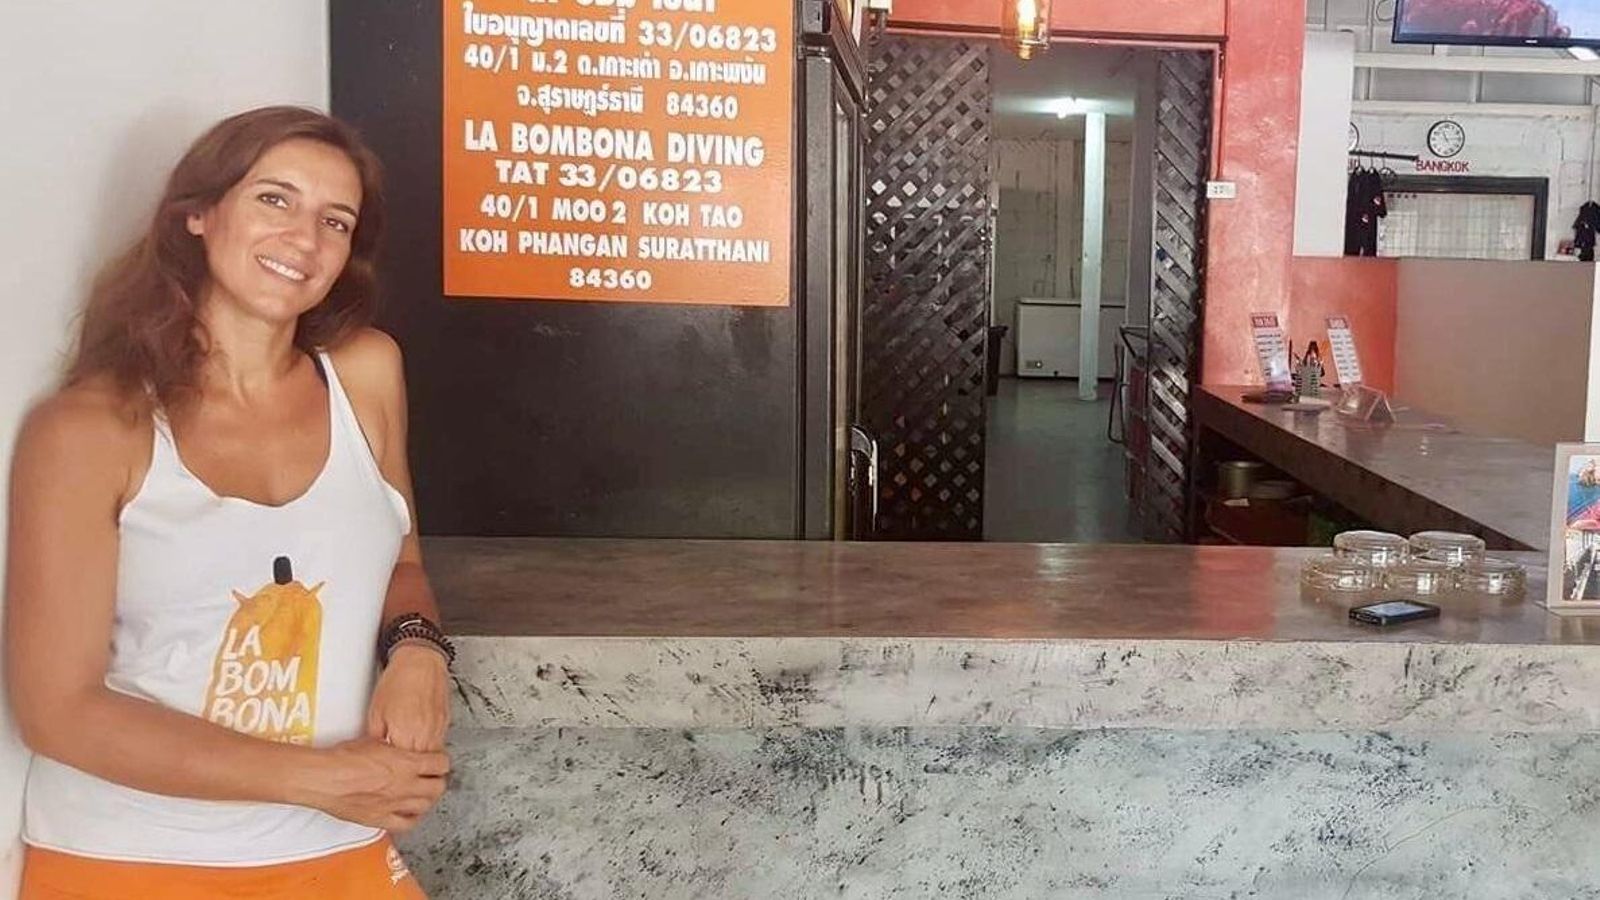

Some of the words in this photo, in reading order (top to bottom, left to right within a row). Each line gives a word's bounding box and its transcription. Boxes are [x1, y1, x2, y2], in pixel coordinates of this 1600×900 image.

[638, 20, 777, 52] 33/06823
[464, 44, 519, 74] 40/1
[531, 49, 568, 74] ม.2
[666, 91, 738, 120] 84360
[465, 119, 498, 152] LA
[511, 122, 654, 161] BOMBONA
[667, 132, 765, 166] DIVING
[495, 159, 549, 185] TAT
[559, 163, 722, 193] 33/06823
[1415, 160, 1470, 173] BANGKOK
[480, 194, 538, 222] 40/1
[552, 198, 606, 222] MOO
[612, 200, 627, 224] 2
[642, 201, 690, 227] KOH
[698, 204, 744, 229] TAO
[459, 229, 508, 253] KOH
[518, 231, 628, 258] PHANGAN
[638, 237, 770, 263] SURATTHANI
[569, 267, 652, 290] 84360
[222, 624, 262, 661] LA
[215, 656, 301, 697] BOM
[209, 692, 311, 734] BONA
